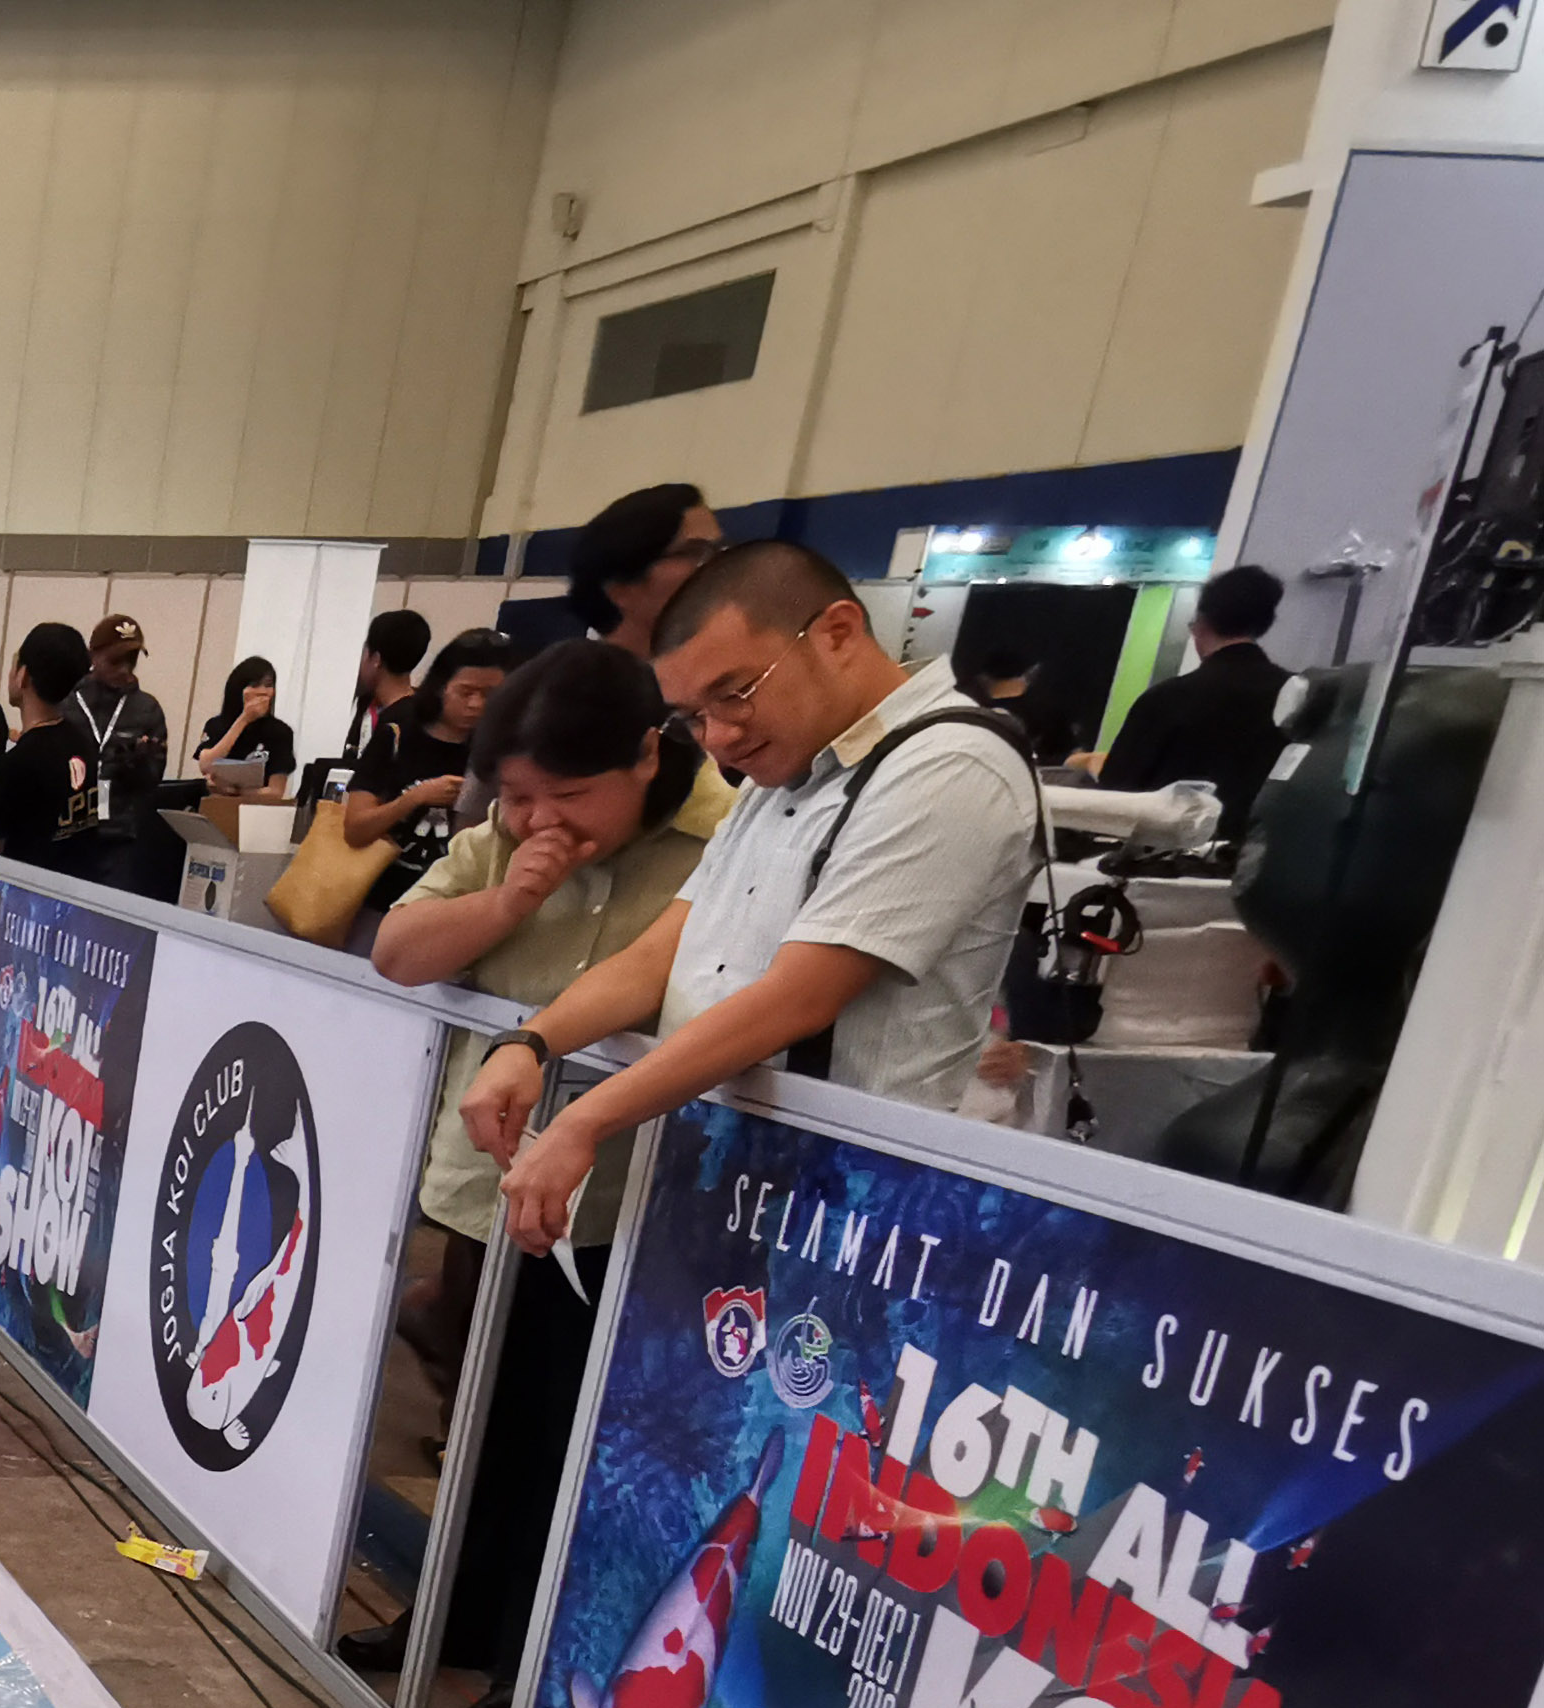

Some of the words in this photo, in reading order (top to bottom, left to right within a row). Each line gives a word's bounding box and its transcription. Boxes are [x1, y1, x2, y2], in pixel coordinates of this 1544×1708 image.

[36, 975, 77, 1039] 16TH
[31, 1088, 96, 1204] KOI
[192, 1057, 245, 1138] CLUB
[166, 1135, 196, 1215] KOI
[160, 1228, 185, 1364] JOGJA
[726, 1172, 942, 1301] SELAMAT
[978, 1257, 1100, 1360] DAN
[1141, 1313, 1430, 1482] SUKSES
[881, 1341, 1100, 1515] 16TH
[1086, 1481, 1257, 1668] ALL
[769, 1538, 830, 1637] NOV
[894, 1612, 921, 1695] 1
